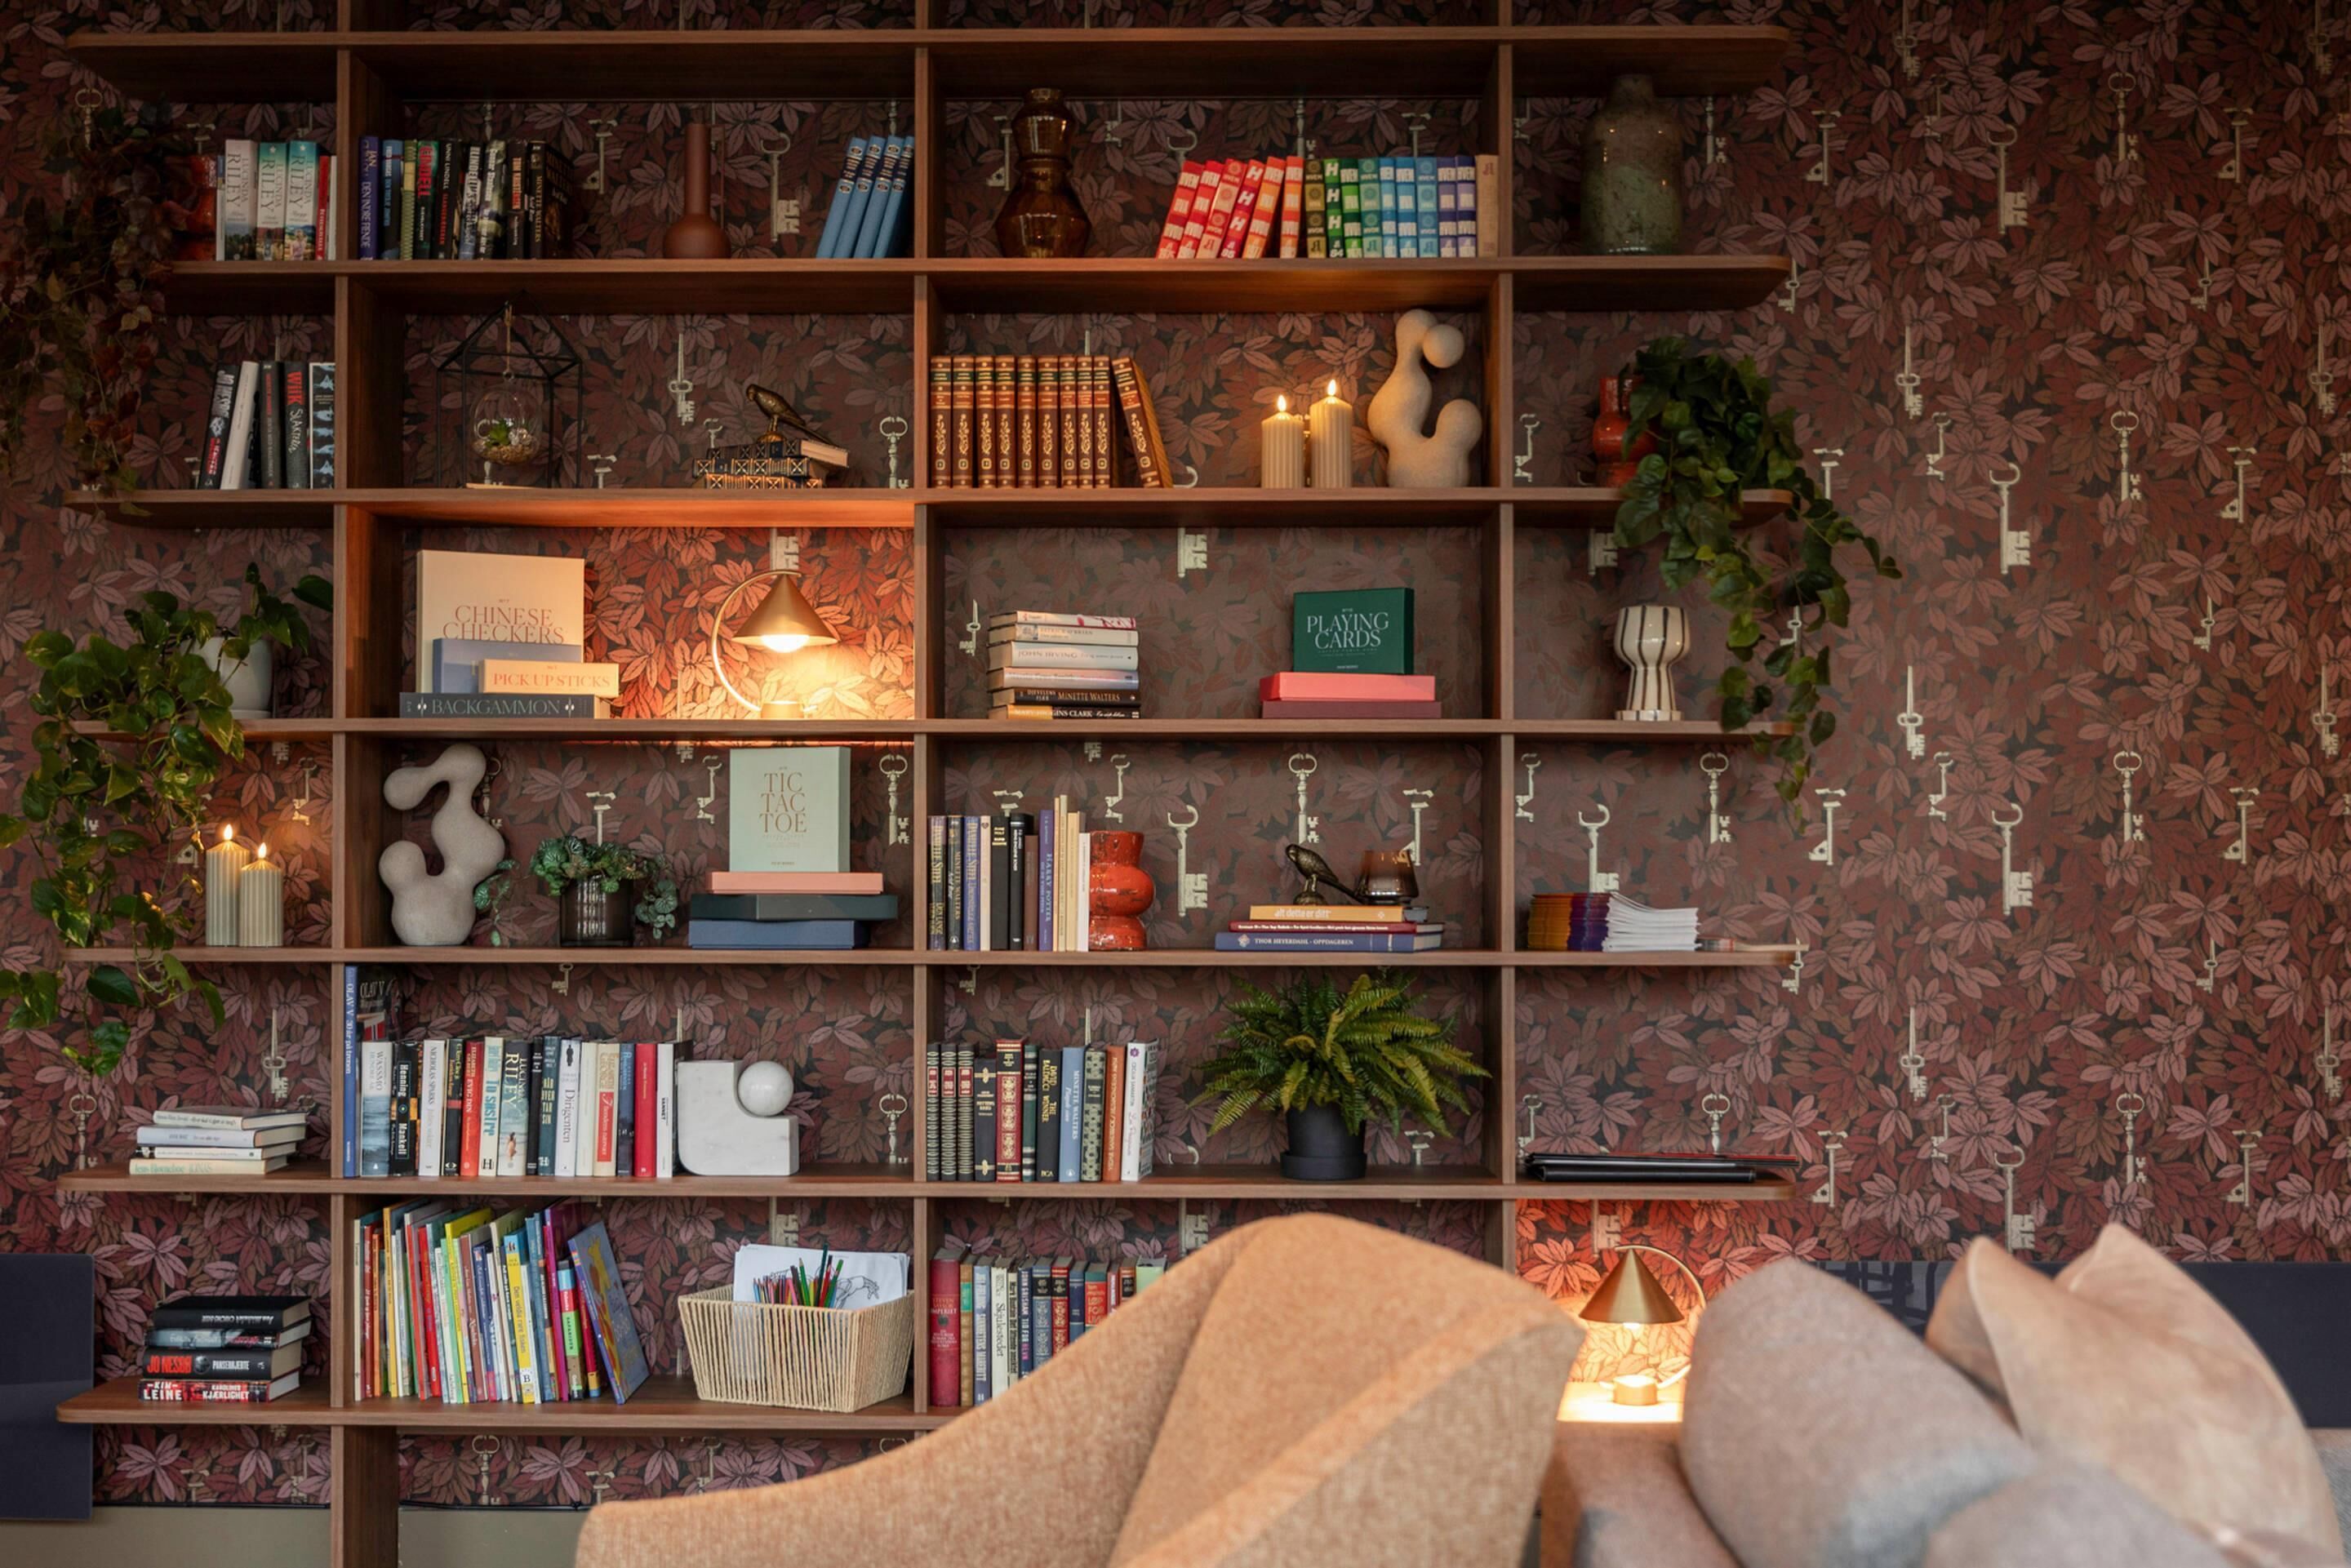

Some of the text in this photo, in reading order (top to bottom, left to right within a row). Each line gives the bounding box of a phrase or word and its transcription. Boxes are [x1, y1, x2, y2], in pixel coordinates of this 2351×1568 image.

[1247, 166, 1263, 180] H
[1325, 162, 1339, 175] H
[227, 153, 242, 207] RILEY
[241, 158, 249, 203] LUCINDA
[260, 158, 276, 211] RILEY
[275, 164, 284, 208] LUCINDA
[289, 155, 305, 208] RILEY
[304, 161, 313, 204] LUCINDA
[1238, 191, 1255, 206] H
[1327, 189, 1340, 202] H
[1229, 216, 1246, 231] H
[1328, 215, 1341, 229] H
[456, 605, 554, 628] CHINESE
[1306, 612, 1389, 633] PLAYING
[443, 622, 565, 644] CHECKERS
[1314, 629, 1381, 650] CARDS
[1018, 650, 1042, 658] JOHN
[494, 673, 611, 688] PICK UP STICKS
[432, 699, 560, 715] BACKGAMMON
[1057, 692, 1120, 701] MINETTE WALTERS
[764, 772, 803, 793] TIC
[761, 793, 806, 813] TAC
[759, 812, 808, 833] TOE
[346, 983, 354, 1006] OLAV
[345, 1019, 353, 1028] 30
[375, 1051, 384, 1090] WASSMO
[429, 1046, 437, 1080] NICHOLAS
[504, 1053, 519, 1108] RILEY
[518, 1057, 527, 1102] LUCINDA
[1042, 1059, 1051, 1090] BALDACCI
[1050, 1065, 1058, 1086] DAVID
[487, 1079, 500, 1092] To
[398, 1064, 409, 1155] Henning Mankell
[562, 1089, 575, 1143] Dirigenten
[1042, 1095, 1050, 1123] WINNER
[993, 1303, 1006, 1357] Skjulestedet
[147, 1356, 160, 1374] JO
[144, 1389, 183, 1401] LEINE
[202, 1390, 250, 1400] KJÆRLIGHET
